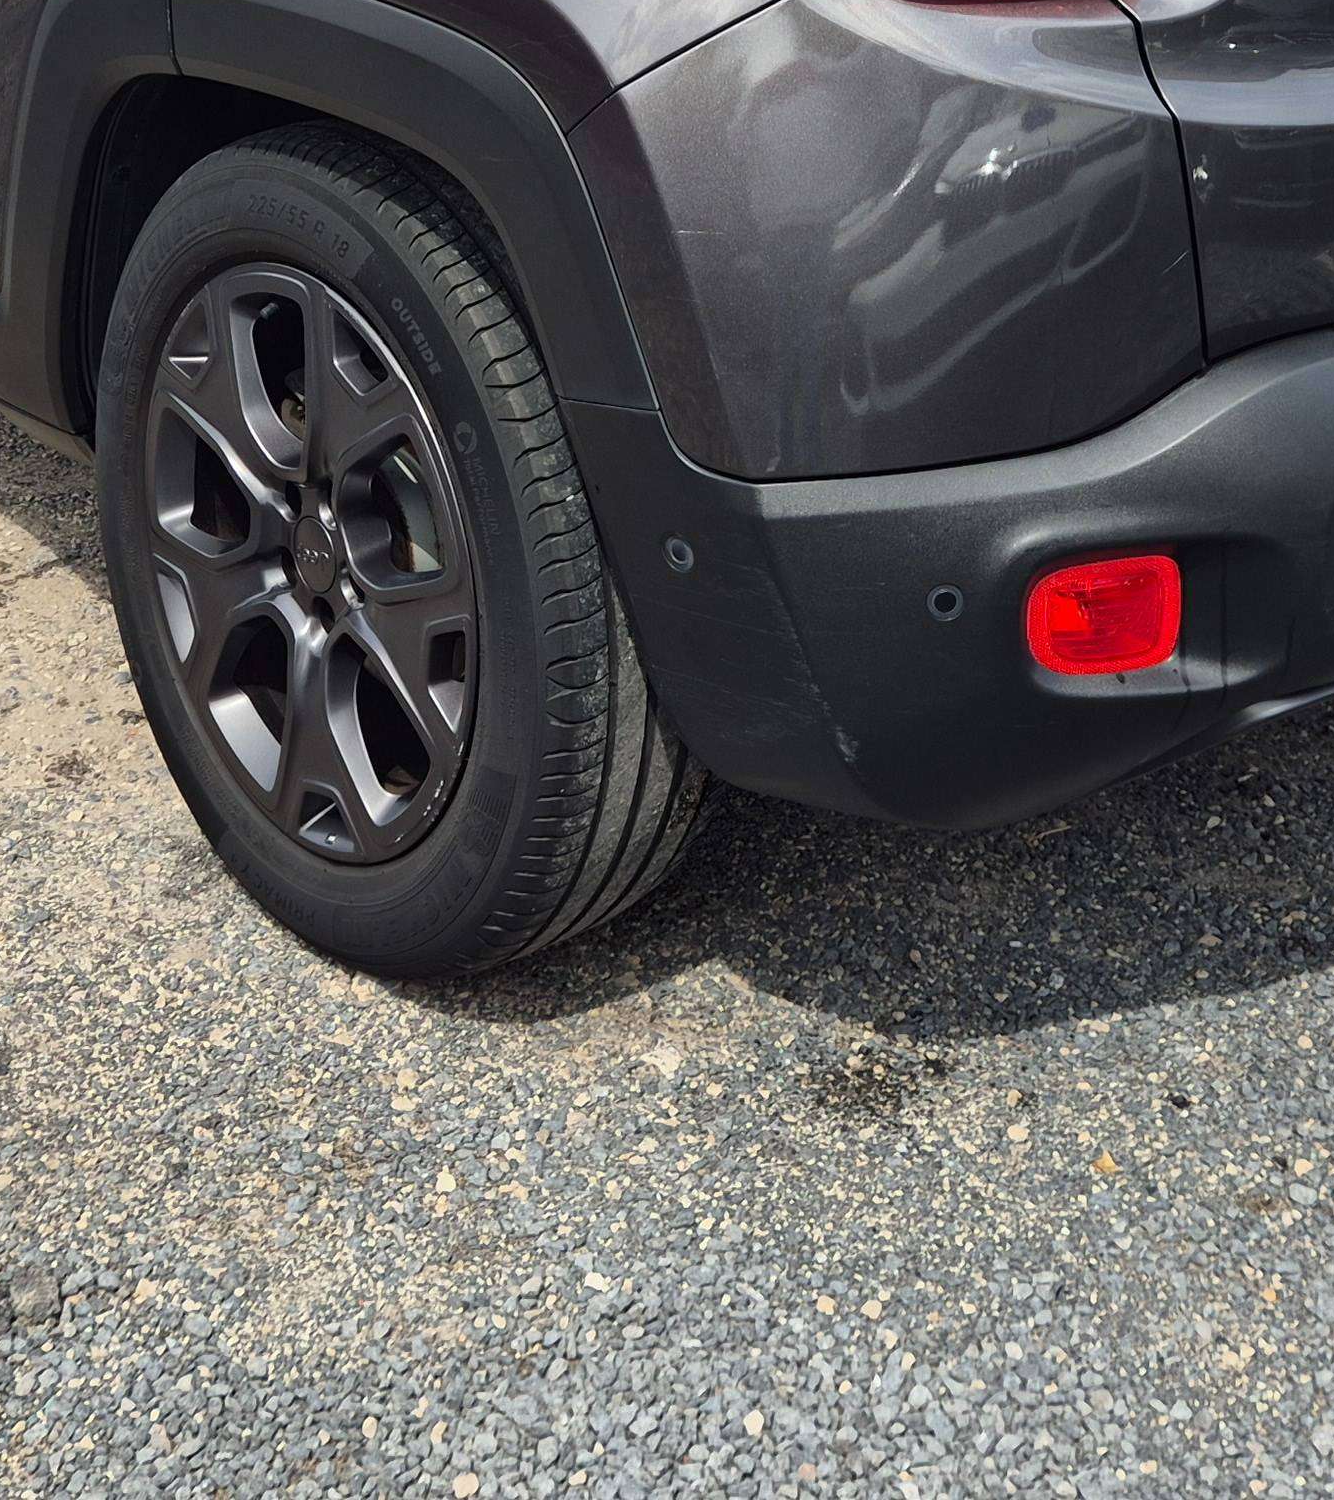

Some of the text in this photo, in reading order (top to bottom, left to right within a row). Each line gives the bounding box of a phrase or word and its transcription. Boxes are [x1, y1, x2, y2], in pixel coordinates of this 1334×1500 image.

[244, 193, 310, 229] 225/55
[331, 233, 351, 259] 18
[391, 297, 443, 377] OUTSIDE
